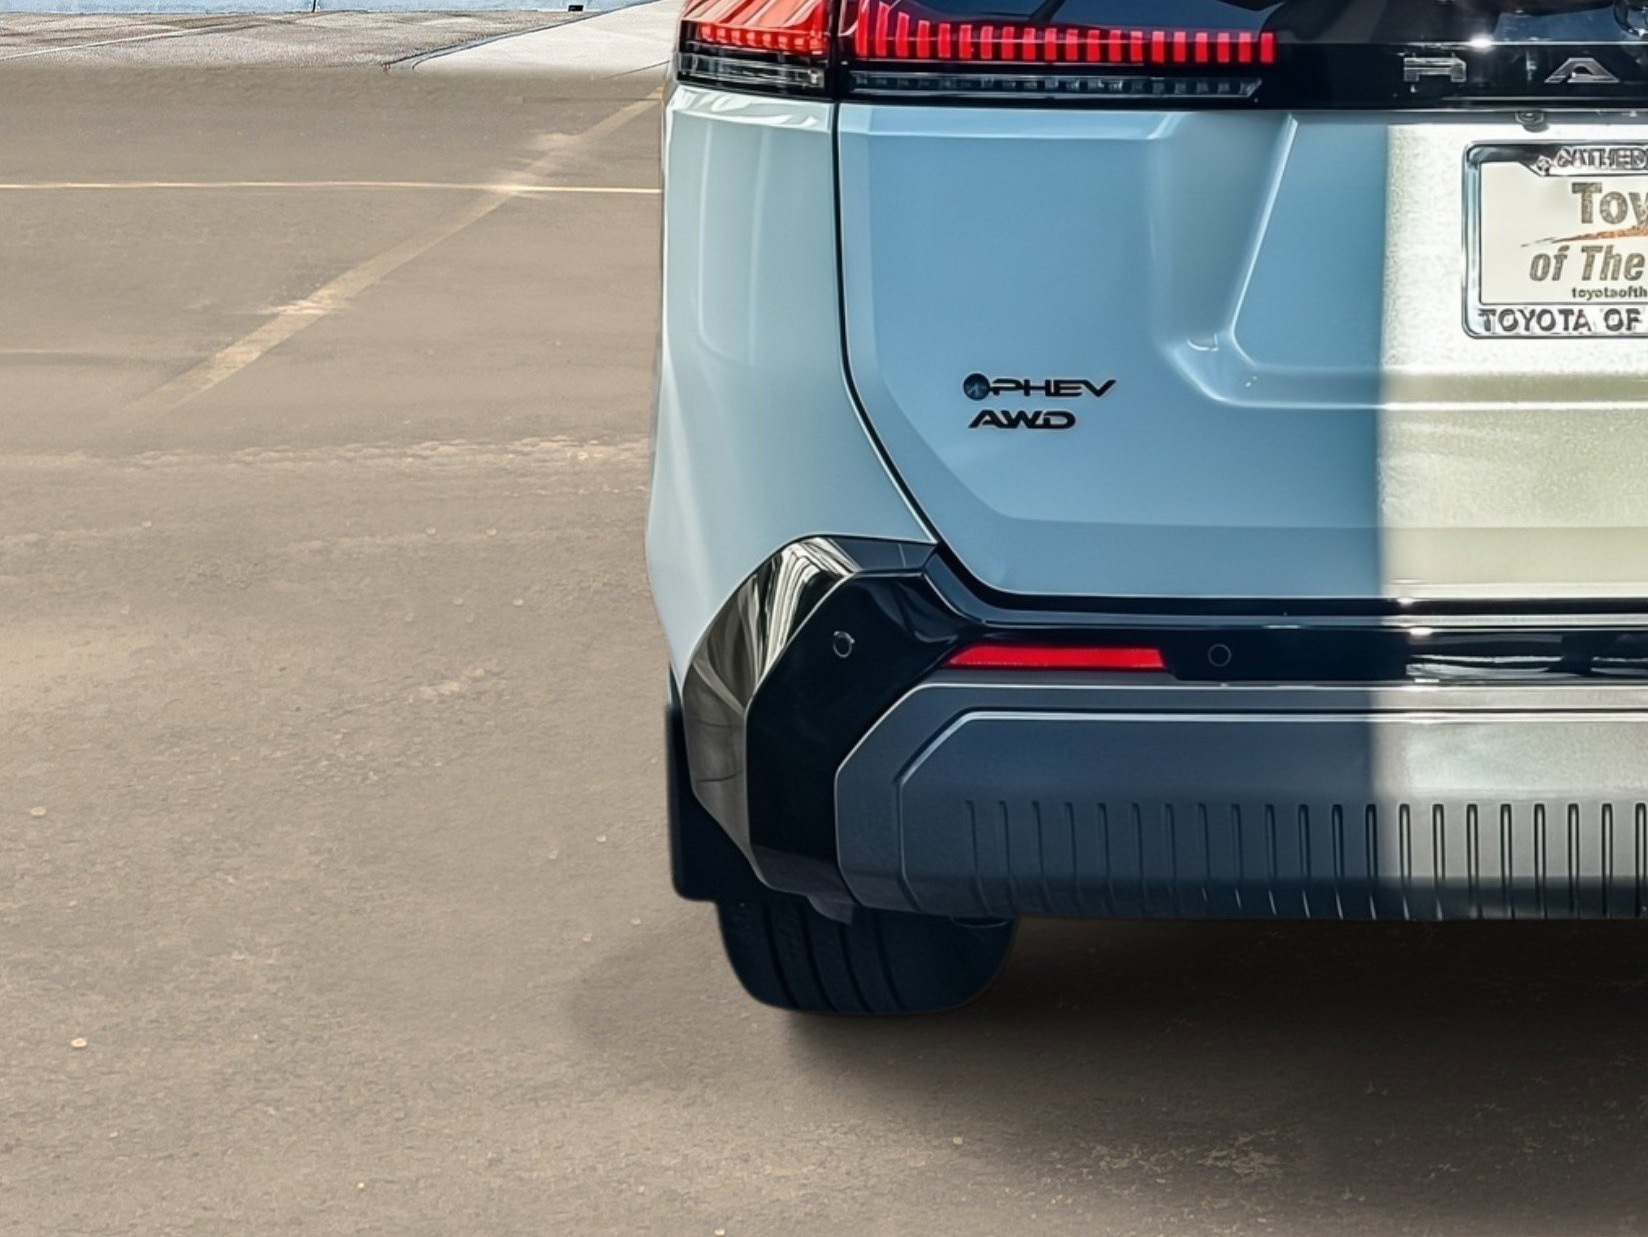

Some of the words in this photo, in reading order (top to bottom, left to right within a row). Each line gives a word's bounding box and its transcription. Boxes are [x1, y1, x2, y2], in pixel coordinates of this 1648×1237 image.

[1528, 247, 1569, 282] of
[1580, 245, 1645, 281] The
[1478, 309, 1593, 332] TOYOTA
[1604, 309, 1641, 331] OF
[991, 378, 1117, 397] PHEV
[968, 409, 1076, 429] AWD
